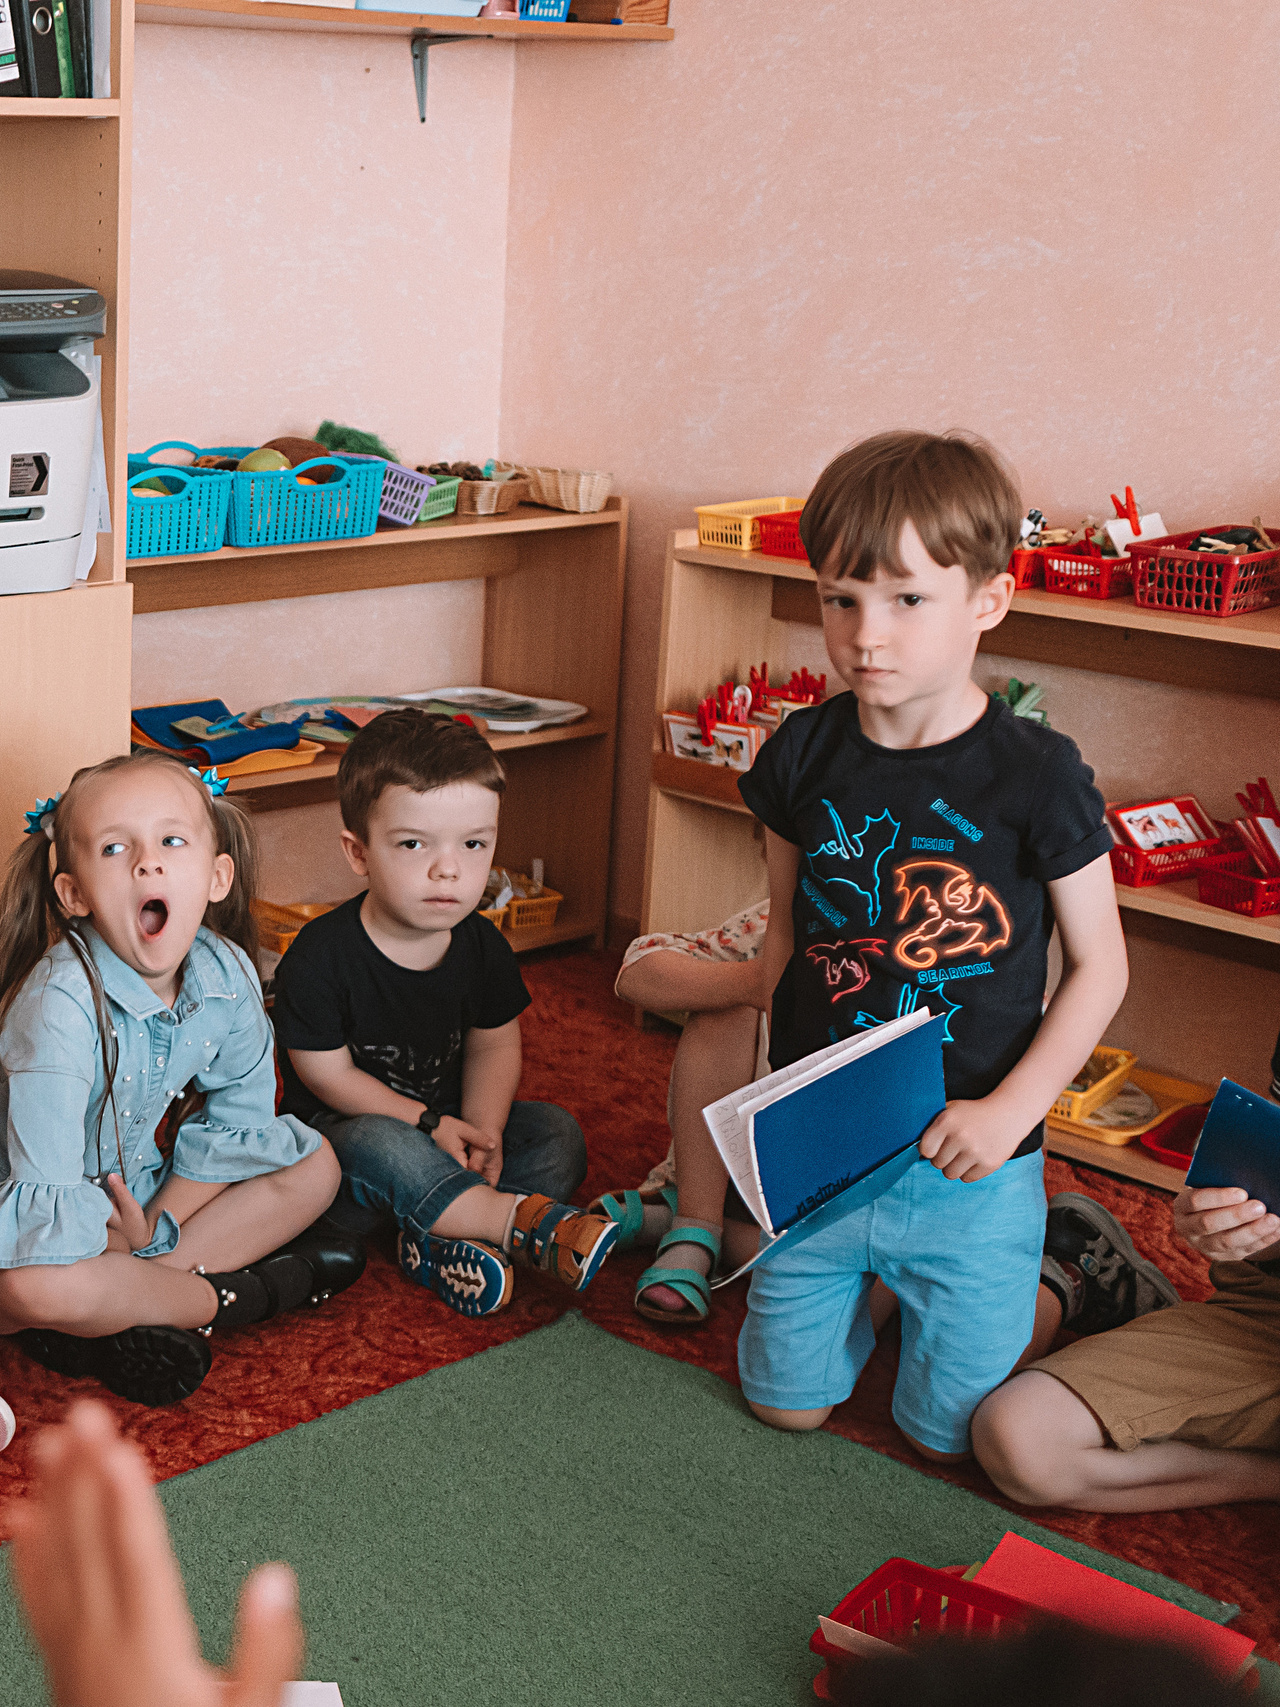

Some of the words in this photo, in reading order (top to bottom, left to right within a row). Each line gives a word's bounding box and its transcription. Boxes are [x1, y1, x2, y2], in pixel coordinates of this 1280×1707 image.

[930, 798, 984, 842] DRAGONS
[911, 836, 955, 852] INSIDE
[917, 961, 995, 984] SEARINOX
